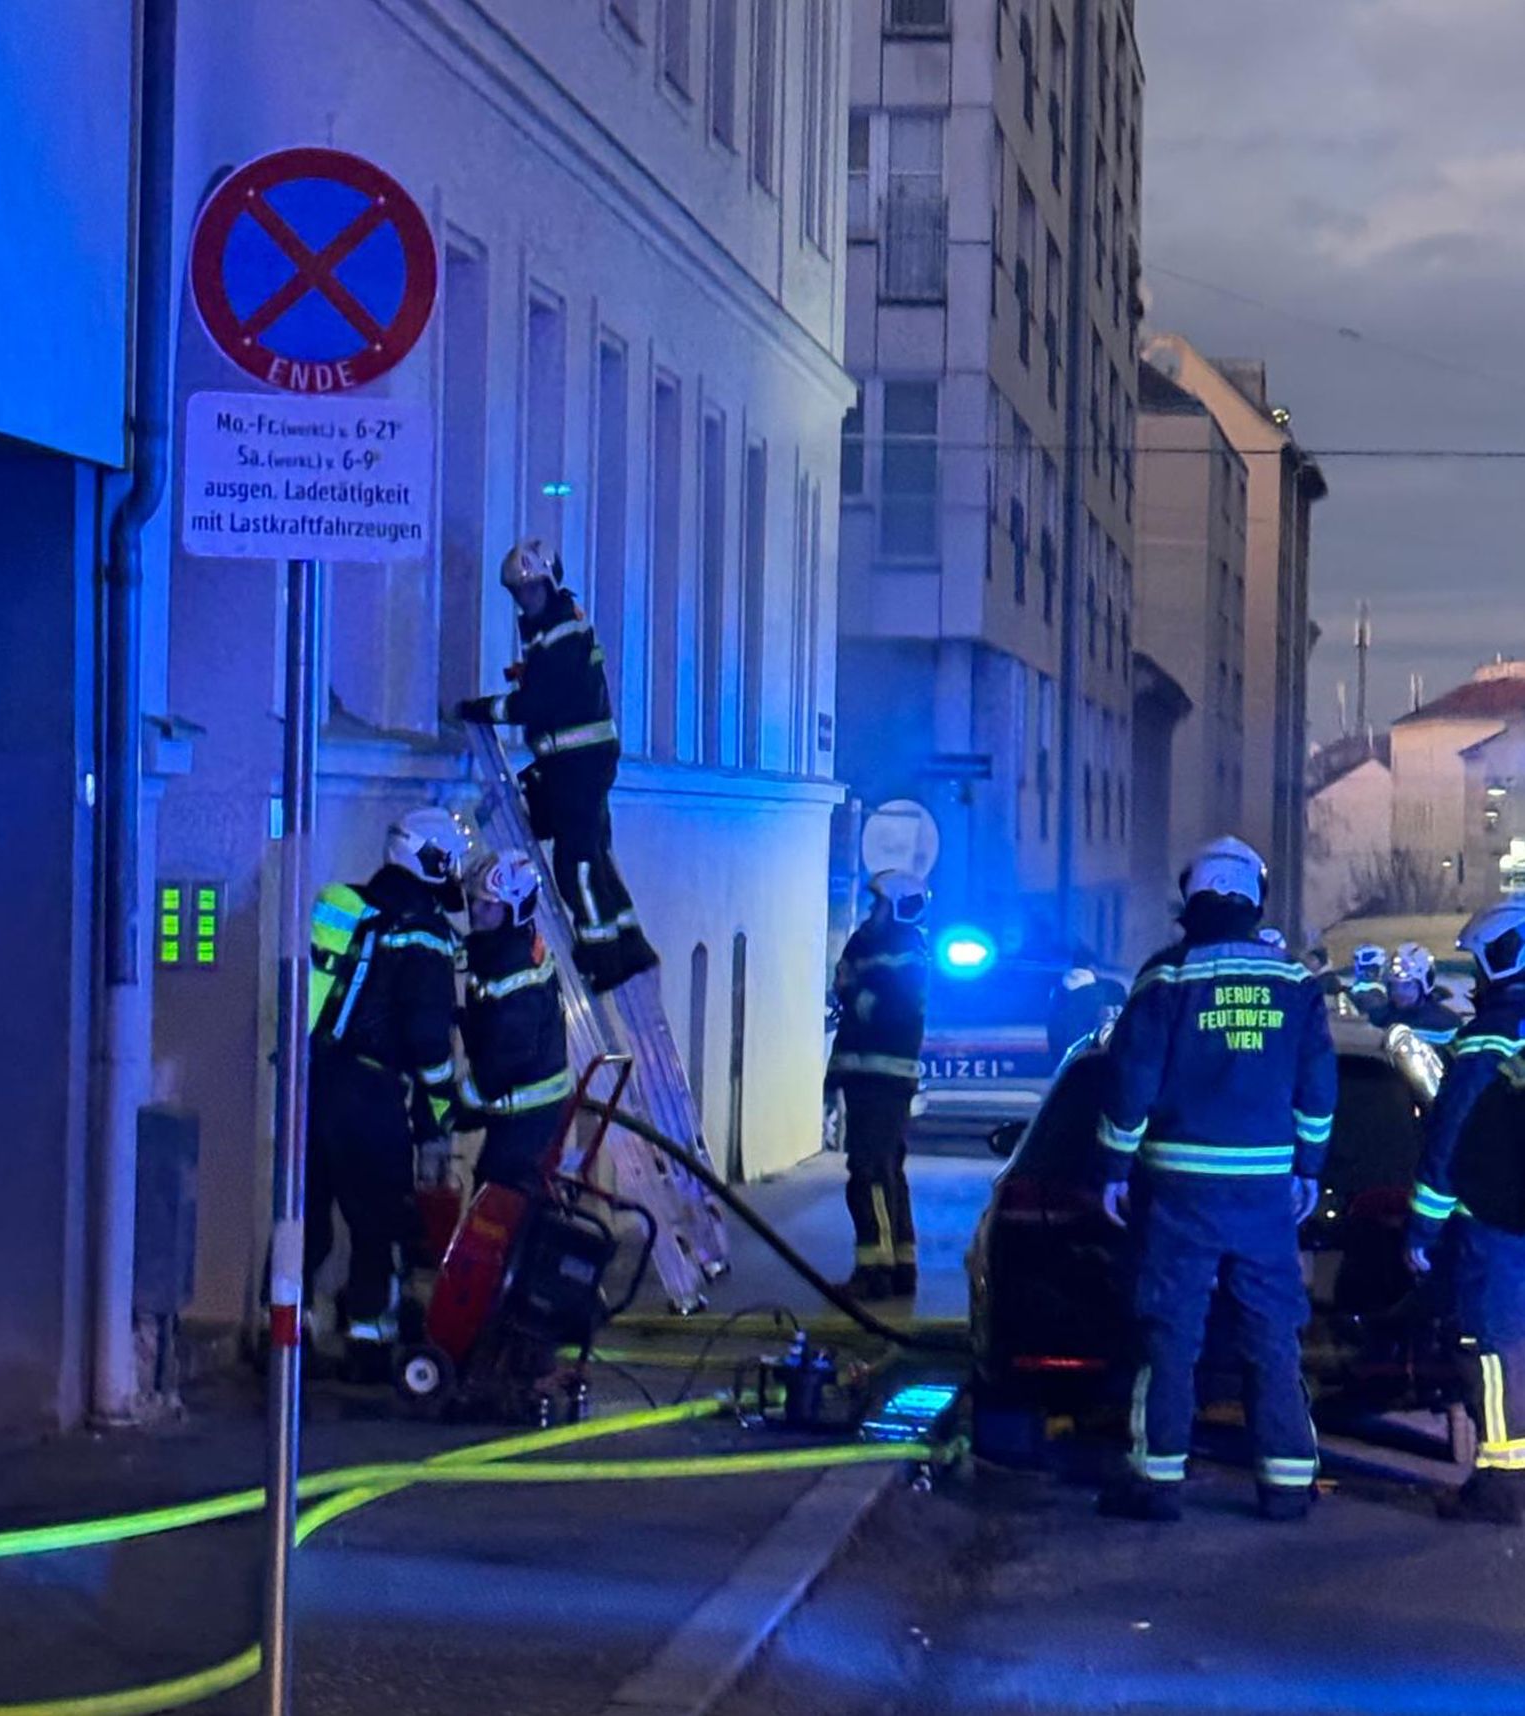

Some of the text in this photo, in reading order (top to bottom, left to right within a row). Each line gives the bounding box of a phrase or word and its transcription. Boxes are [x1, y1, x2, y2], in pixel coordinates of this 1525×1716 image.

[268, 357, 355, 391] ENDE
[204, 478, 410, 508] ausgen. Ladetätigkeit
[191, 510, 422, 544] mit Lastkraftfahrzeugen
[1215, 986, 1271, 1006] BERUFS
[1225, 1031, 1264, 1052] WIEN
[916, 1059, 998, 1078] OLIZEI
